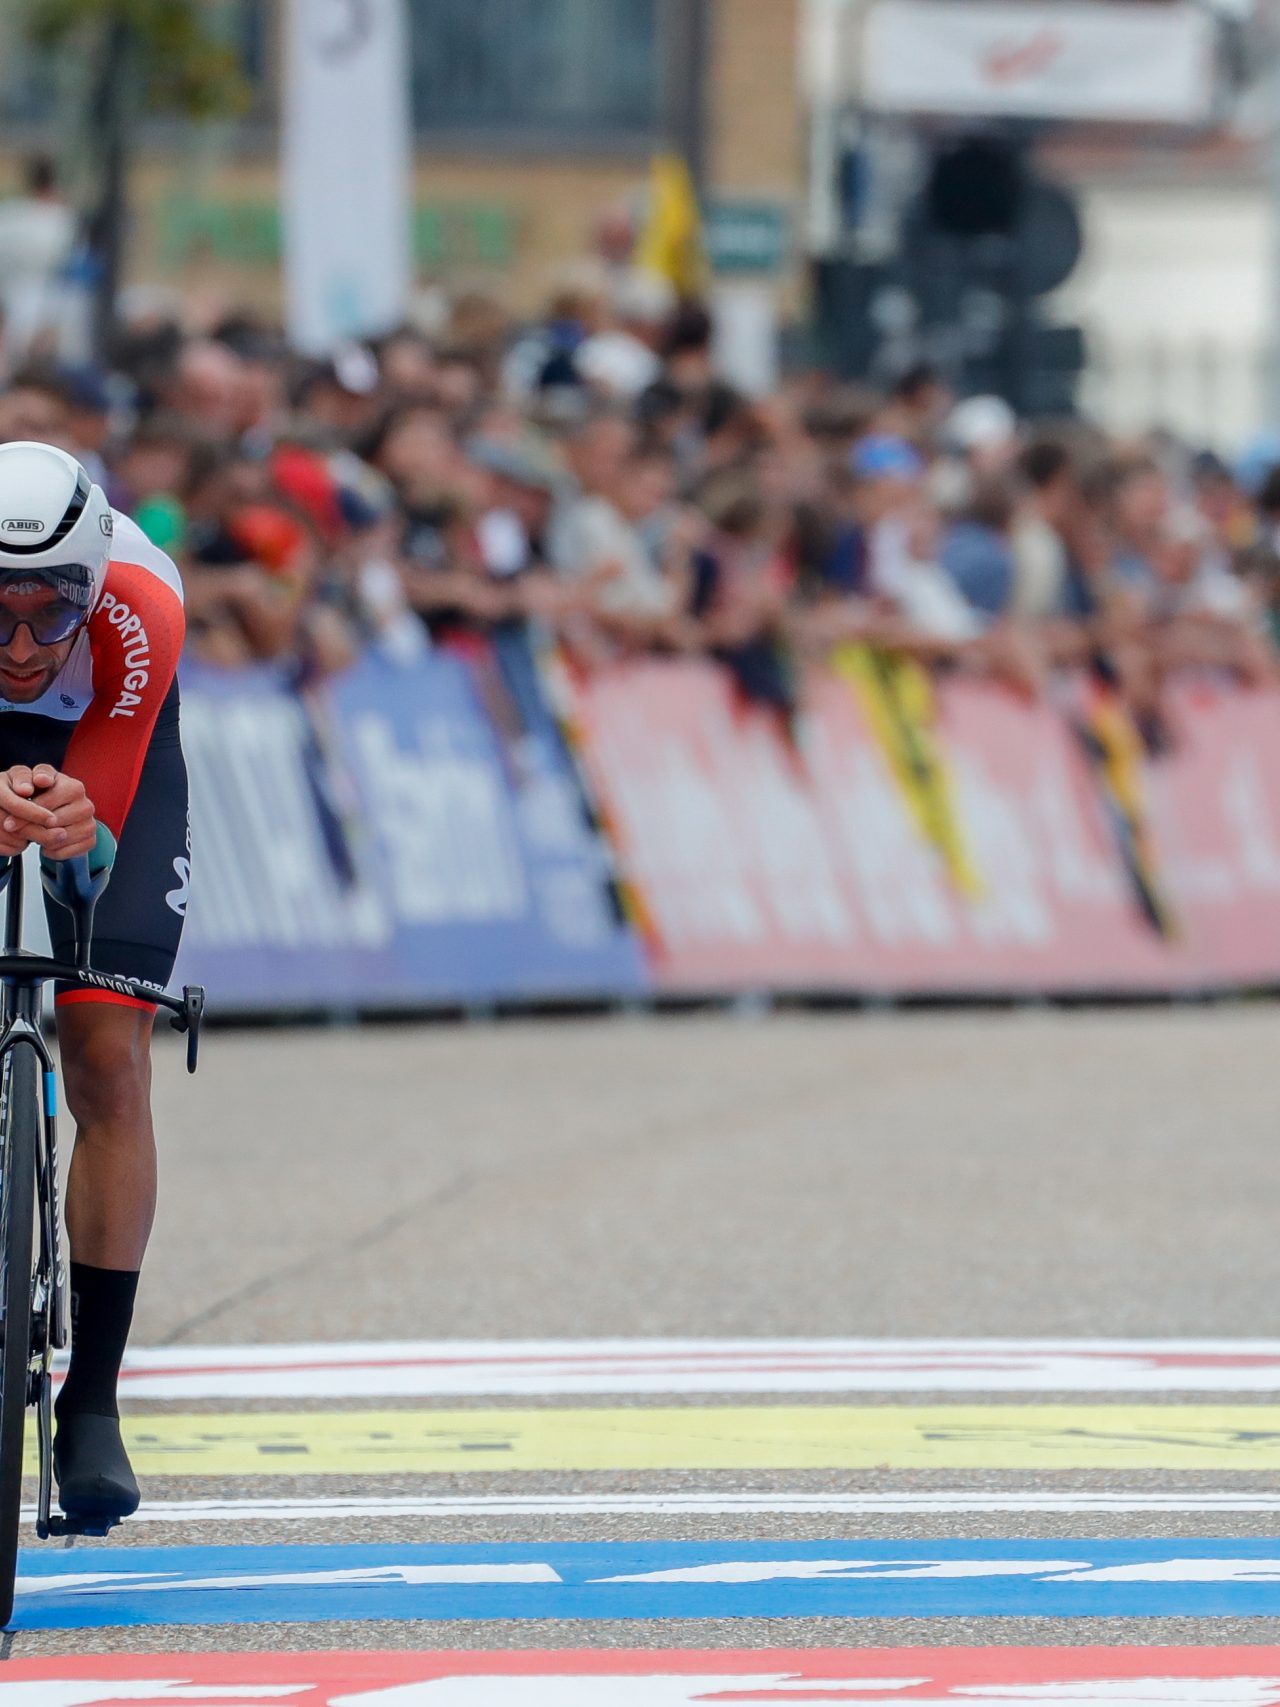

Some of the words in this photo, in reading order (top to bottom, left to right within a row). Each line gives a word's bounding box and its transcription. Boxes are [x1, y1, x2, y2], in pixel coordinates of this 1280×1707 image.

[7, 520, 39, 530] ABUS
[96, 591, 150, 718] PORTUGAL
[78, 970, 135, 997] CANYON
